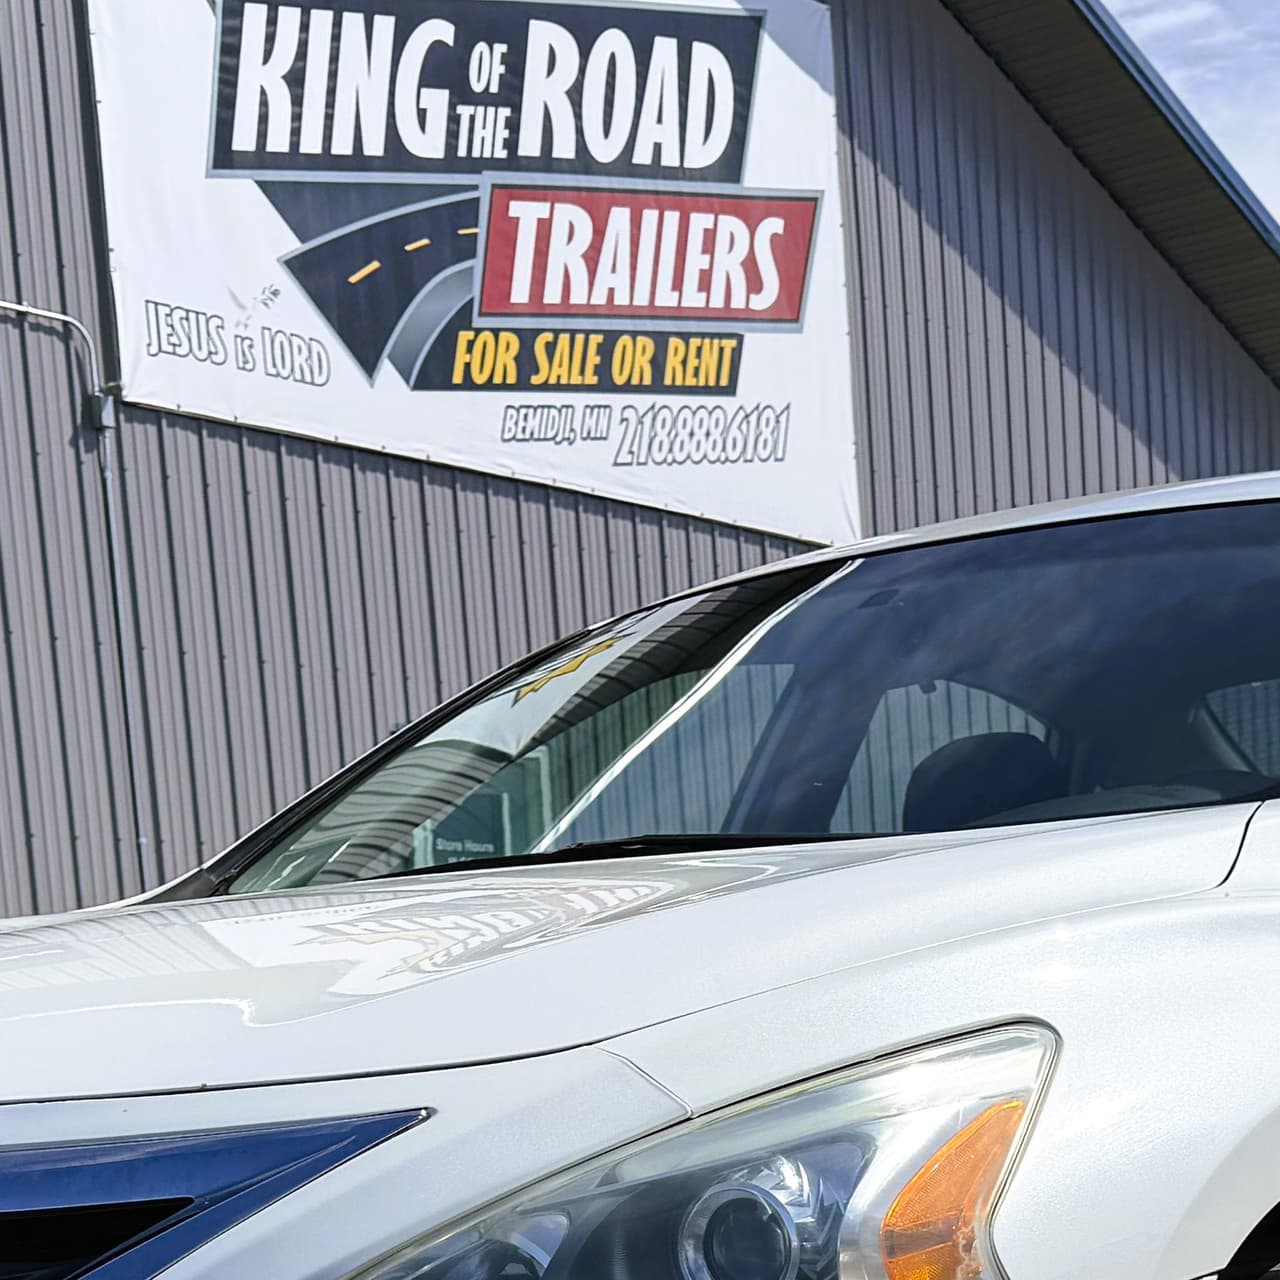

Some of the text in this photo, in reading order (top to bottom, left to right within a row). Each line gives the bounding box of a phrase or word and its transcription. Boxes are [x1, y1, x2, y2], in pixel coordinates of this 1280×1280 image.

[231, 2, 735, 170] KING OF THE ROAD
[507, 201, 784, 311] TRAILERS
[145, 299, 228, 366] JESUS
[261, 326, 331, 388] LORD
[451, 330, 738, 388] FOR SALE OR RENT
[501, 401, 791, 467] BEMIDJI, MN 218.888.6181
[435, 837, 495, 853] Store Hours
